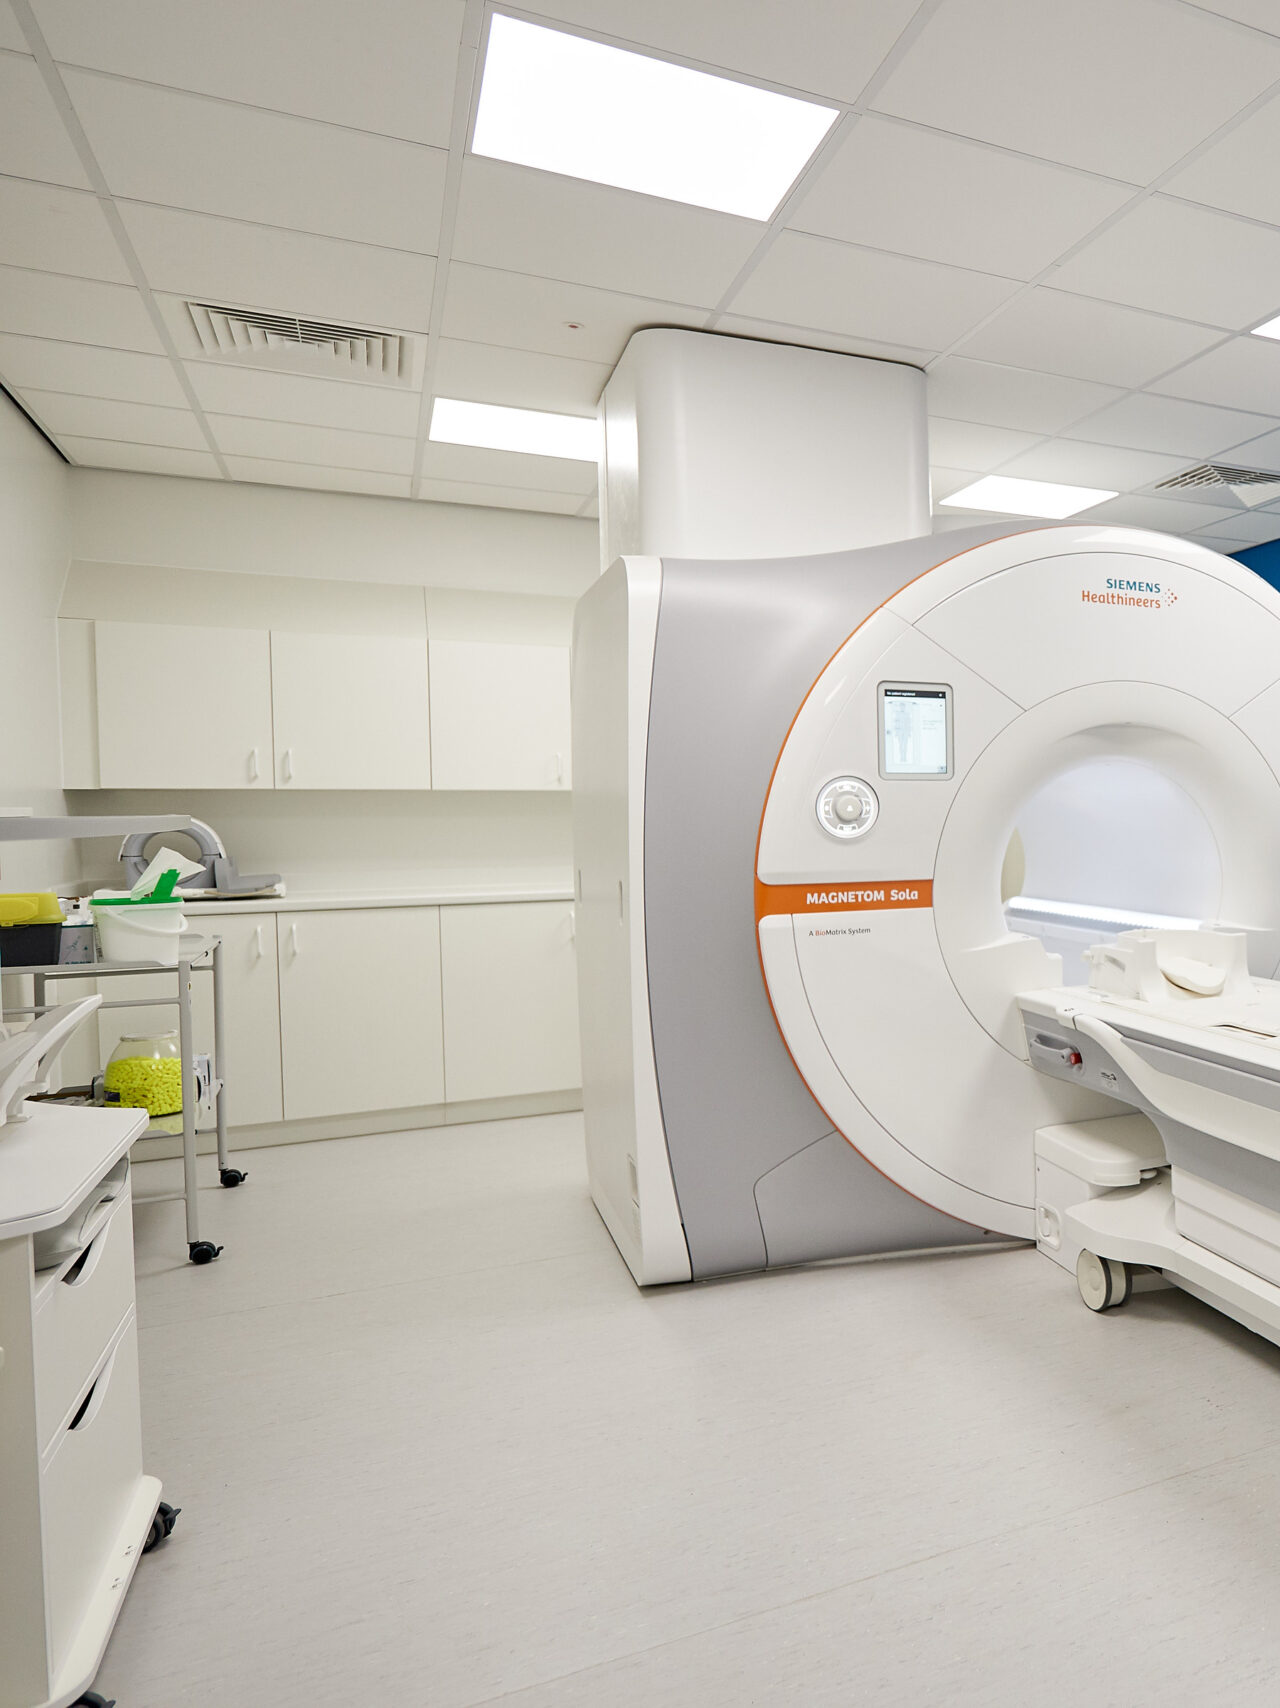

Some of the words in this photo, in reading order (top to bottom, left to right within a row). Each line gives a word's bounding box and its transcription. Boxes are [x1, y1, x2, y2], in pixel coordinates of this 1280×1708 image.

[1106, 578, 1161, 593] SIEMENS
[1081, 590, 1161, 608] Healthineers
[806, 890, 885, 905] MAGNETOM
[890, 888, 918, 901] Sola
[815, 929, 847, 937] BioMatrix
[848, 927, 871, 935] System
